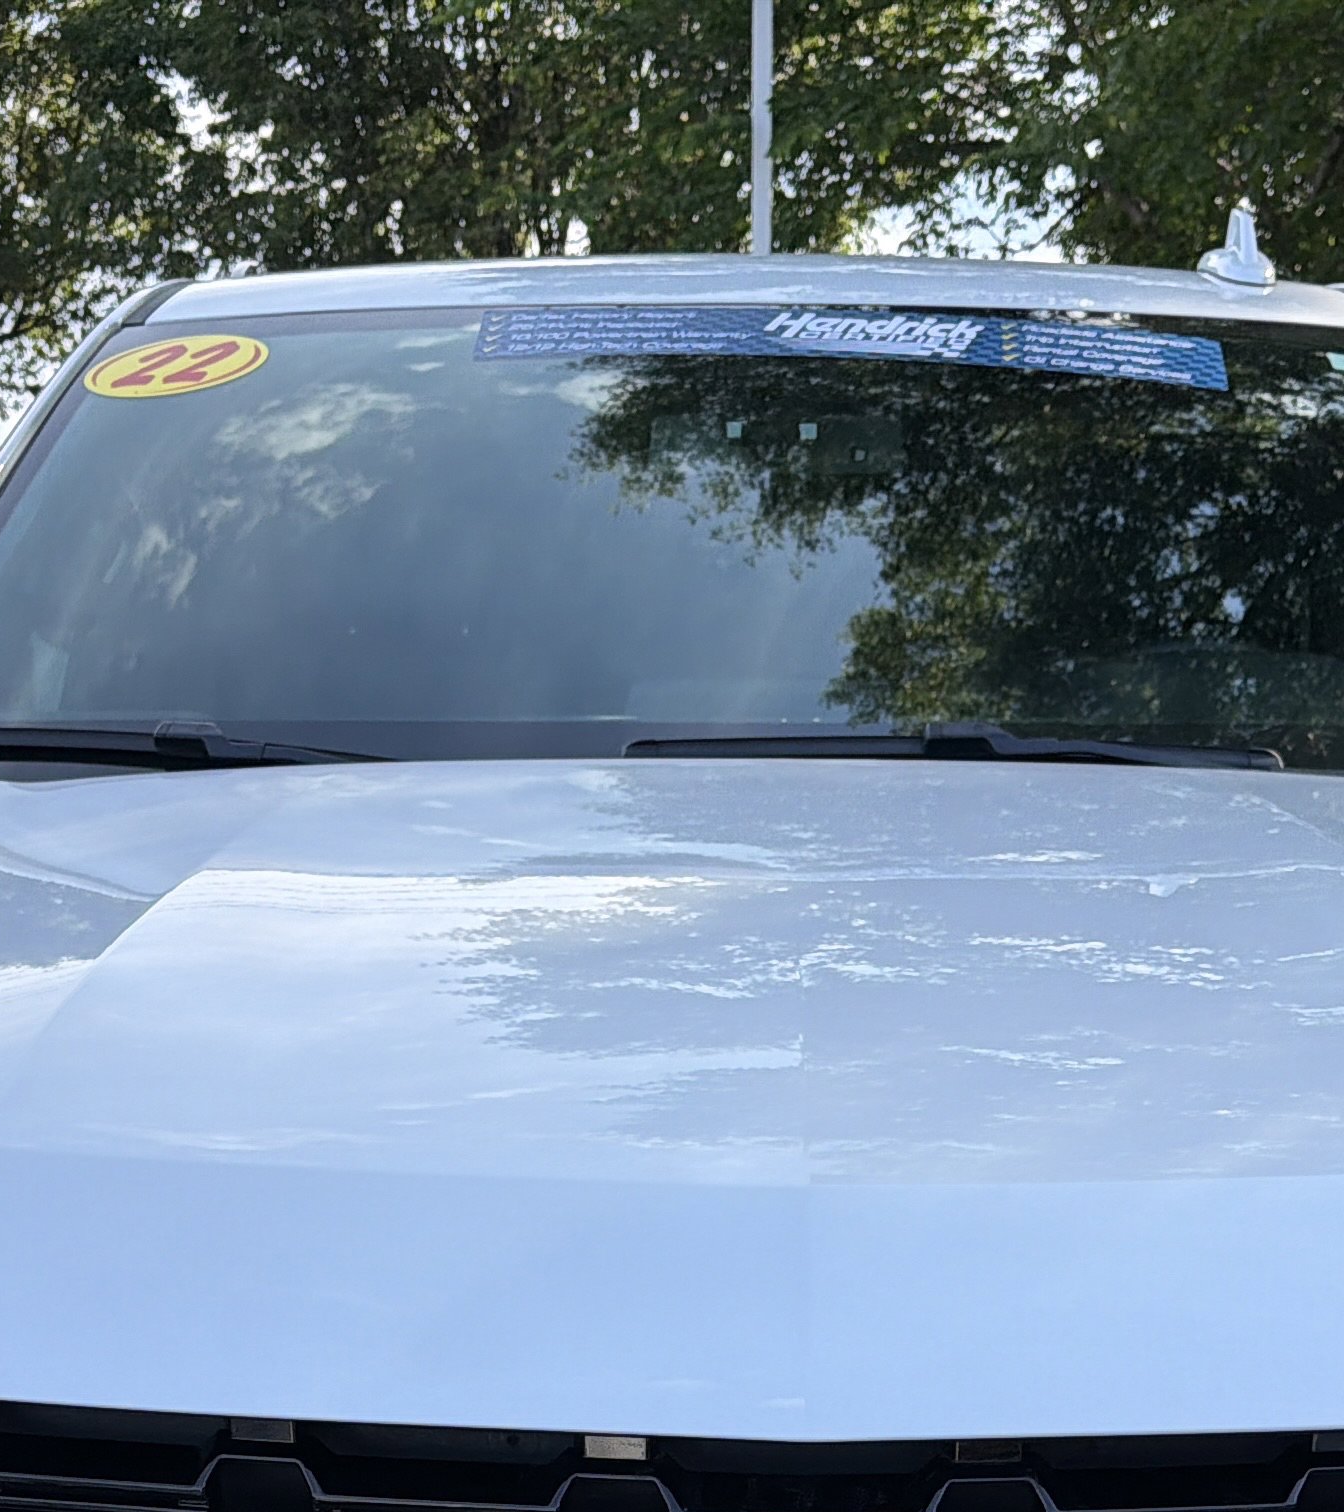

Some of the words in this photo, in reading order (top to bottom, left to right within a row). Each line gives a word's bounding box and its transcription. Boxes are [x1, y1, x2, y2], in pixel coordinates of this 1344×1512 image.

[671, 331, 755, 340] Warranty
[763, 312, 986, 338] Hendrick
[1024, 335, 1055, 345] Trip
[111, 341, 241, 389] 22
[1023, 344, 1079, 356] Rental
[1082, 349, 1166, 366] Coverage
[1050, 357, 1116, 372] Change
[1118, 363, 1193, 381] Services
